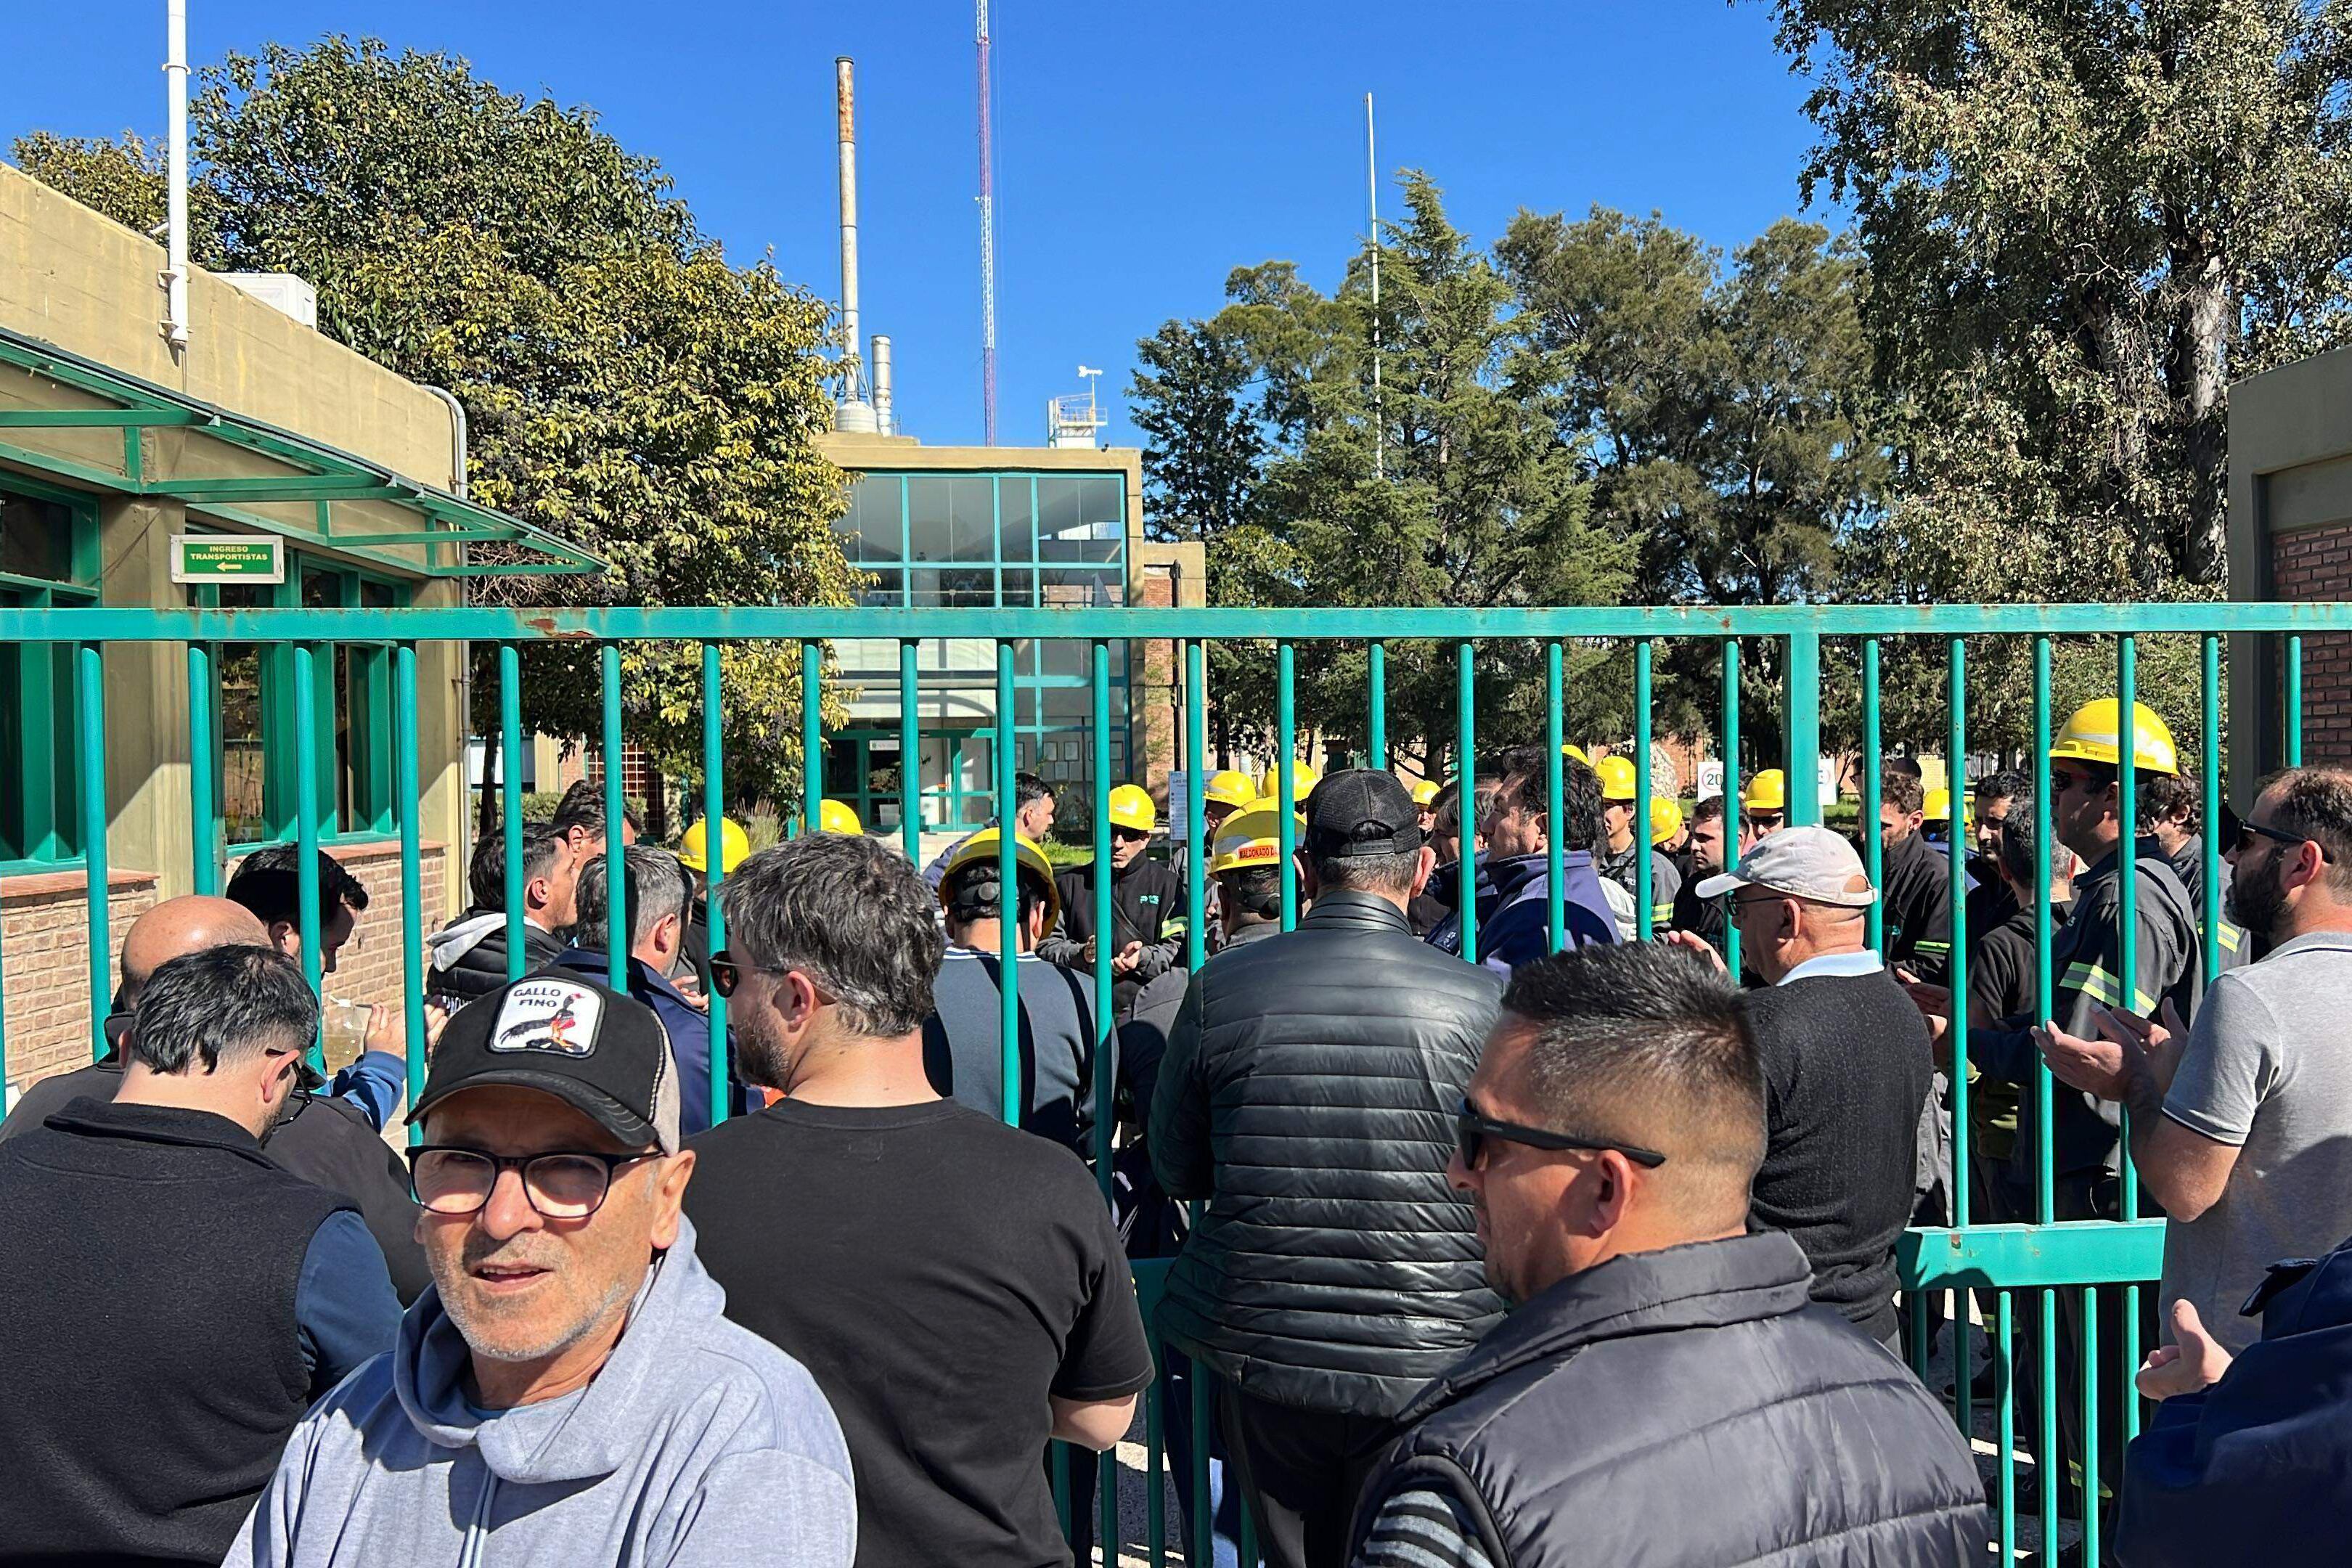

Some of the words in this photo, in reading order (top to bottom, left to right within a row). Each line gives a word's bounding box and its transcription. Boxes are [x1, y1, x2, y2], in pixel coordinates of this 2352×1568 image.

[1707, 773, 1723, 785] 20
[513, 987, 561, 997] GALLO
[519, 999, 558, 1008] FINO
